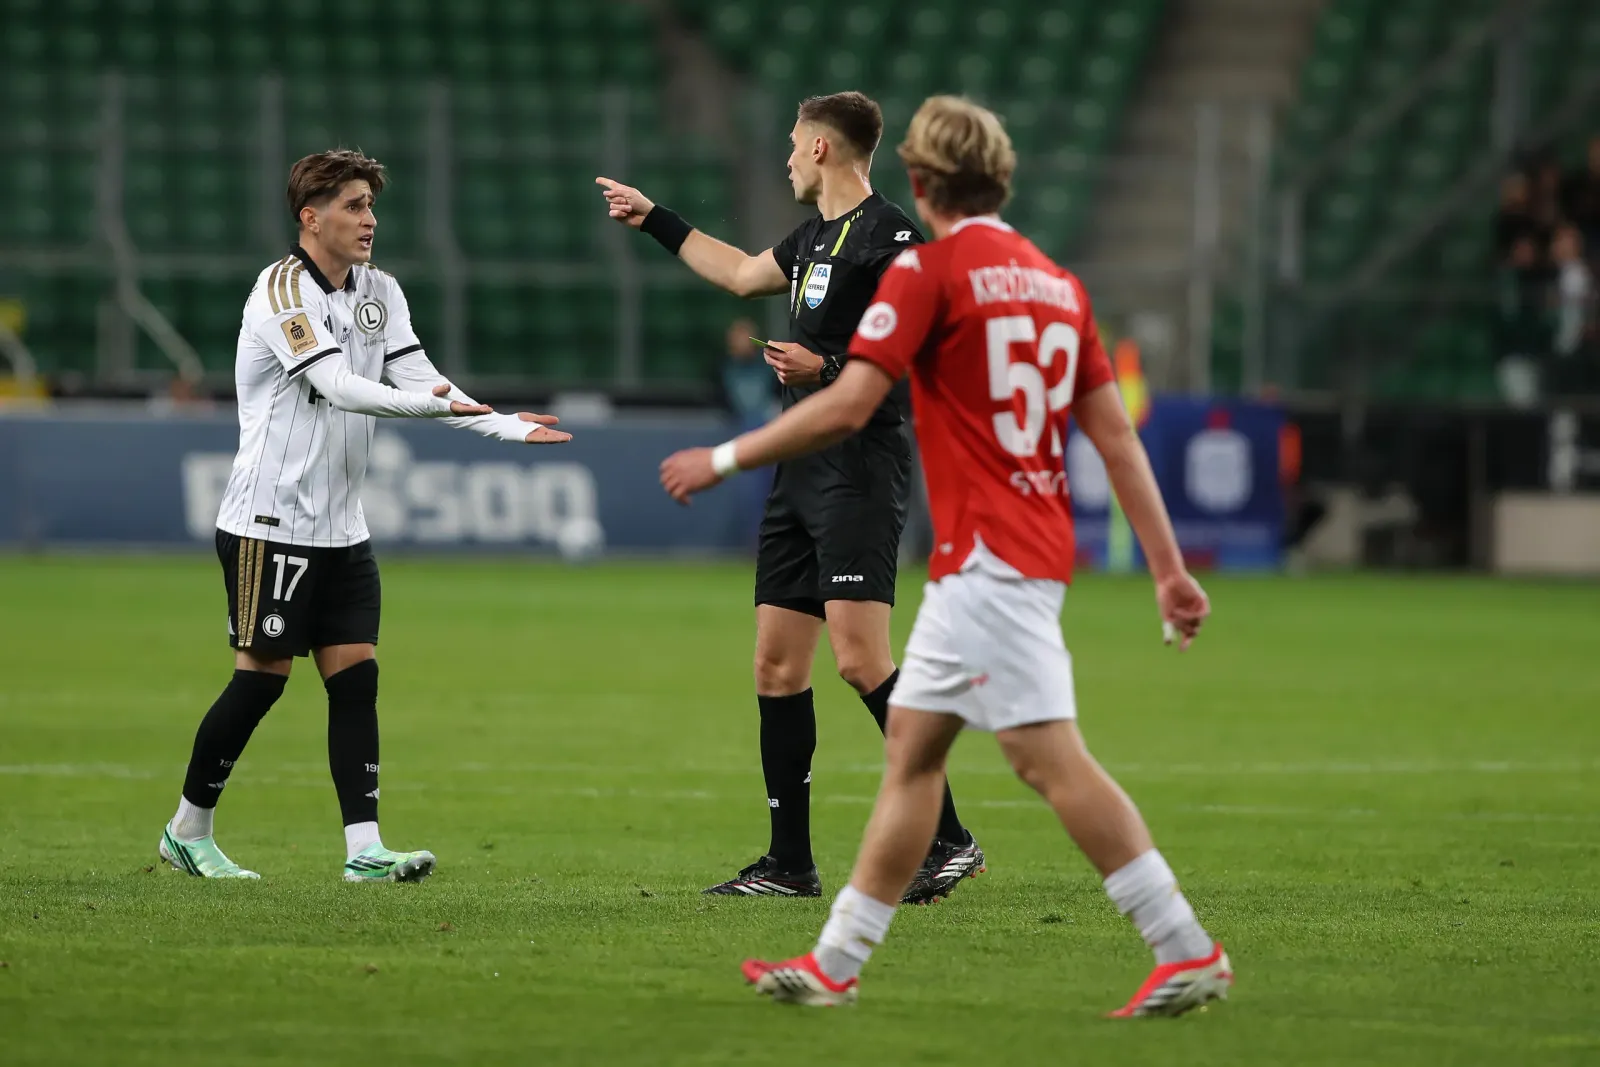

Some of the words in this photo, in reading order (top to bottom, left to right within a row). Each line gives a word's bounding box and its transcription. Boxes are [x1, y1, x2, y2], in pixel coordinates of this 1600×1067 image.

[812, 267, 828, 278] FIFA
[364, 308, 377, 325] L
[985, 315, 1080, 458] 52
[273, 553, 309, 602] 17
[831, 574, 864, 583] zina
